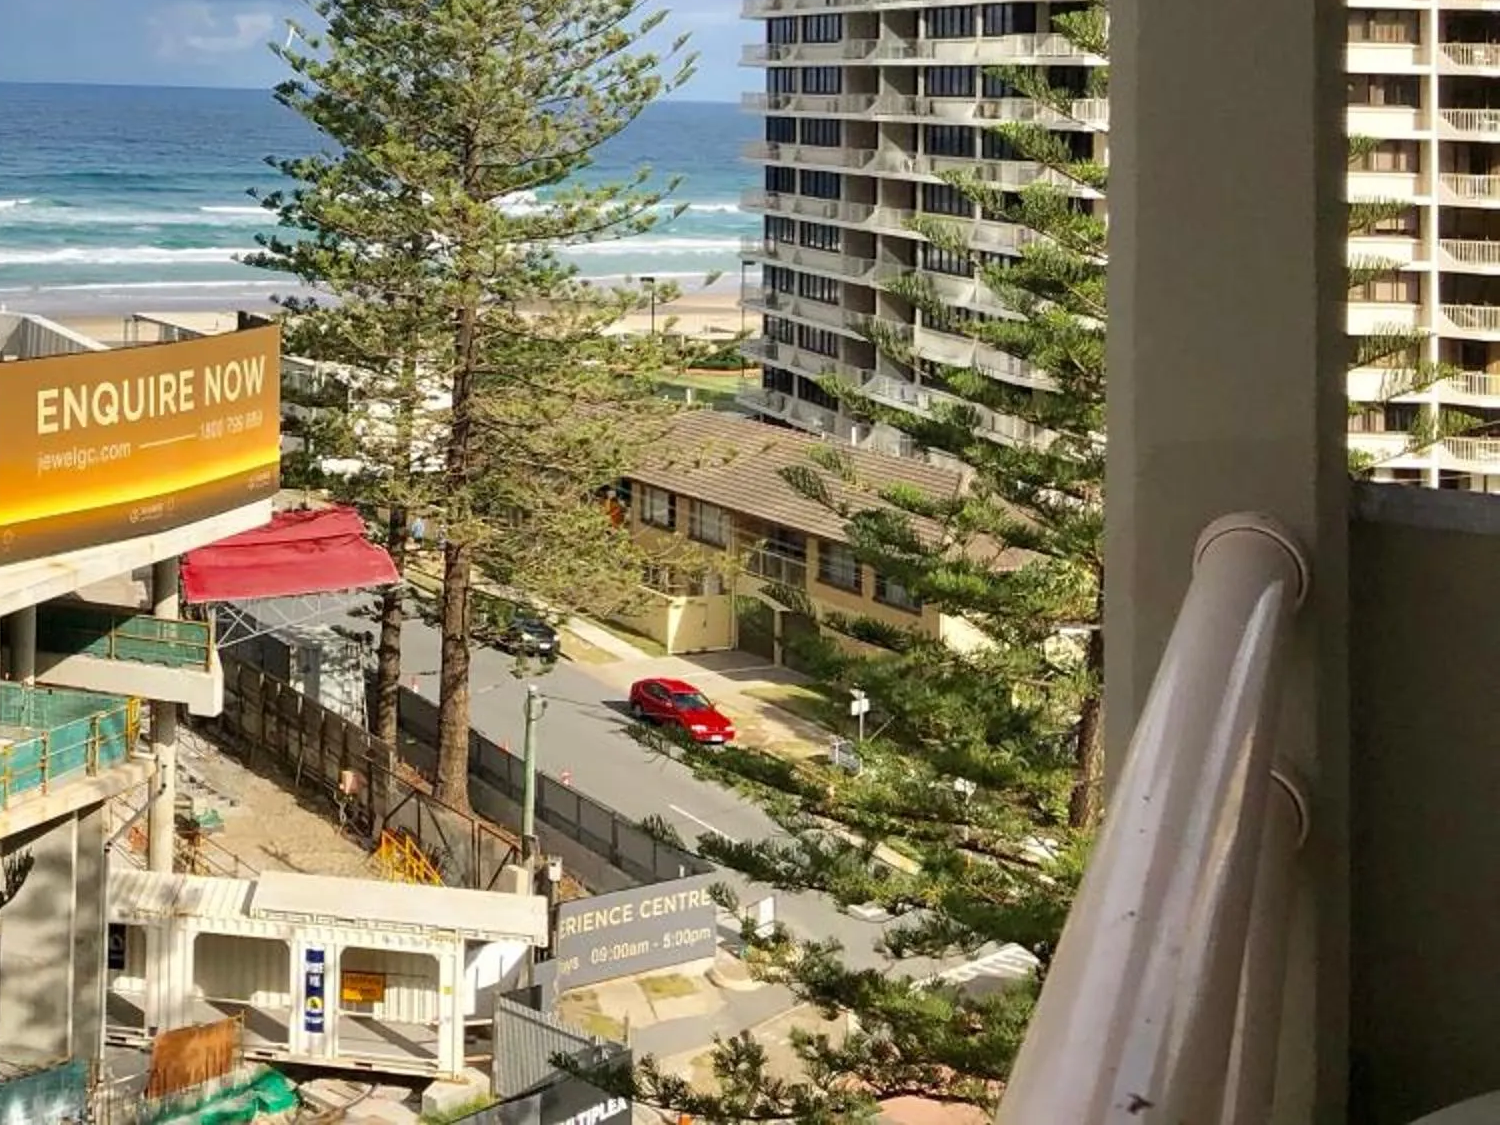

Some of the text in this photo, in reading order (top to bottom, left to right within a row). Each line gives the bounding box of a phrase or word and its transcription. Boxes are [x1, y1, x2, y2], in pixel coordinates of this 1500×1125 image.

[37, 356, 266, 435] ENQUIRE NOW
[37, 442, 131, 477] jewelgc.com
[640, 888, 711, 918] CENTRE
